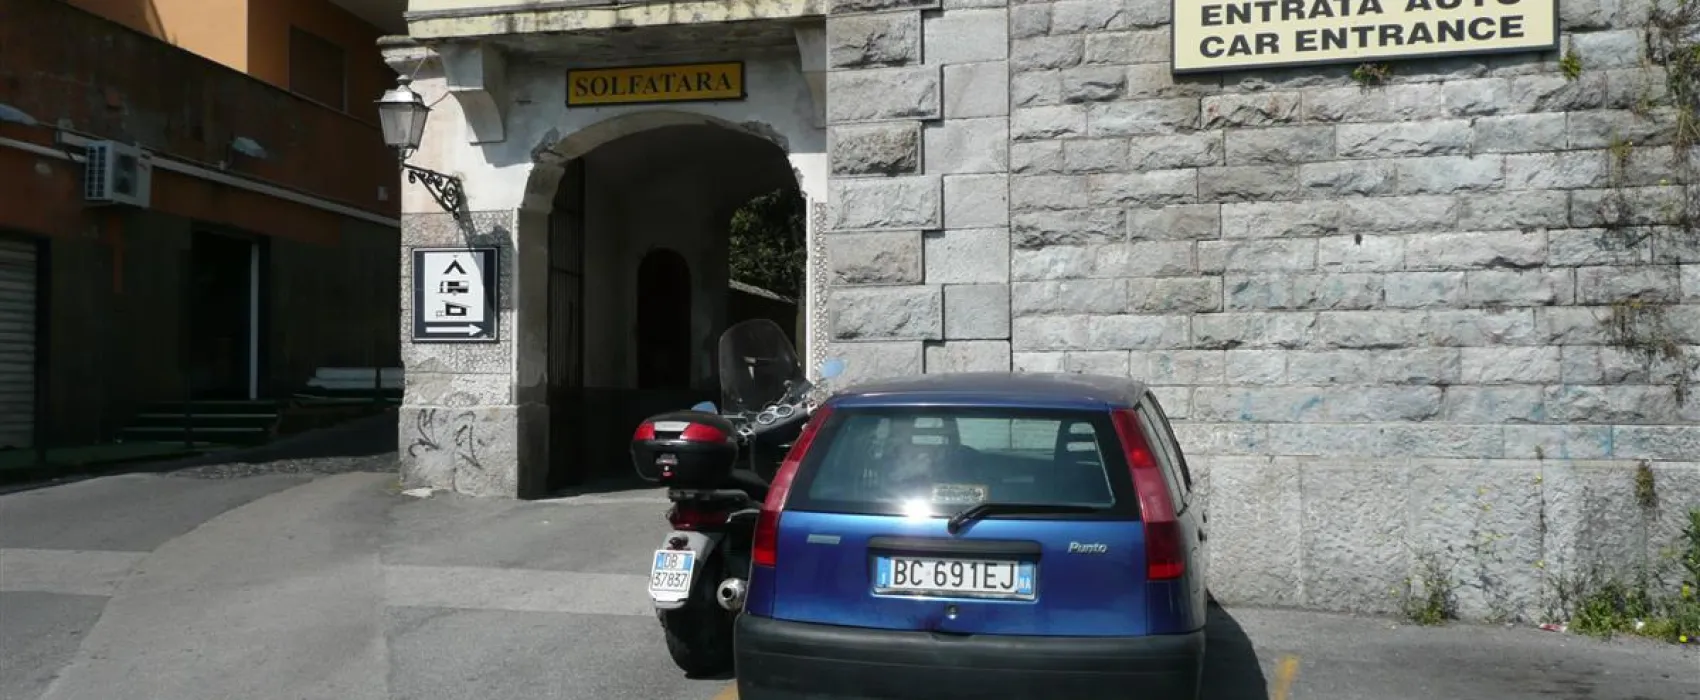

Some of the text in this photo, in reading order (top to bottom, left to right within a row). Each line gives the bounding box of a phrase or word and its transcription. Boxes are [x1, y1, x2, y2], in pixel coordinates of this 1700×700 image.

[1201, 0, 1383, 26] ENTRATA
[1199, 14, 1524, 58] CAR ENTRANCE
[574, 71, 733, 97] SOLFATARA
[1067, 540, 1107, 553] Punto
[664, 553, 678, 568] DB
[653, 572, 688, 587] 37837
[893, 559, 923, 586] BC
[934, 560, 1015, 590] 691EJ
